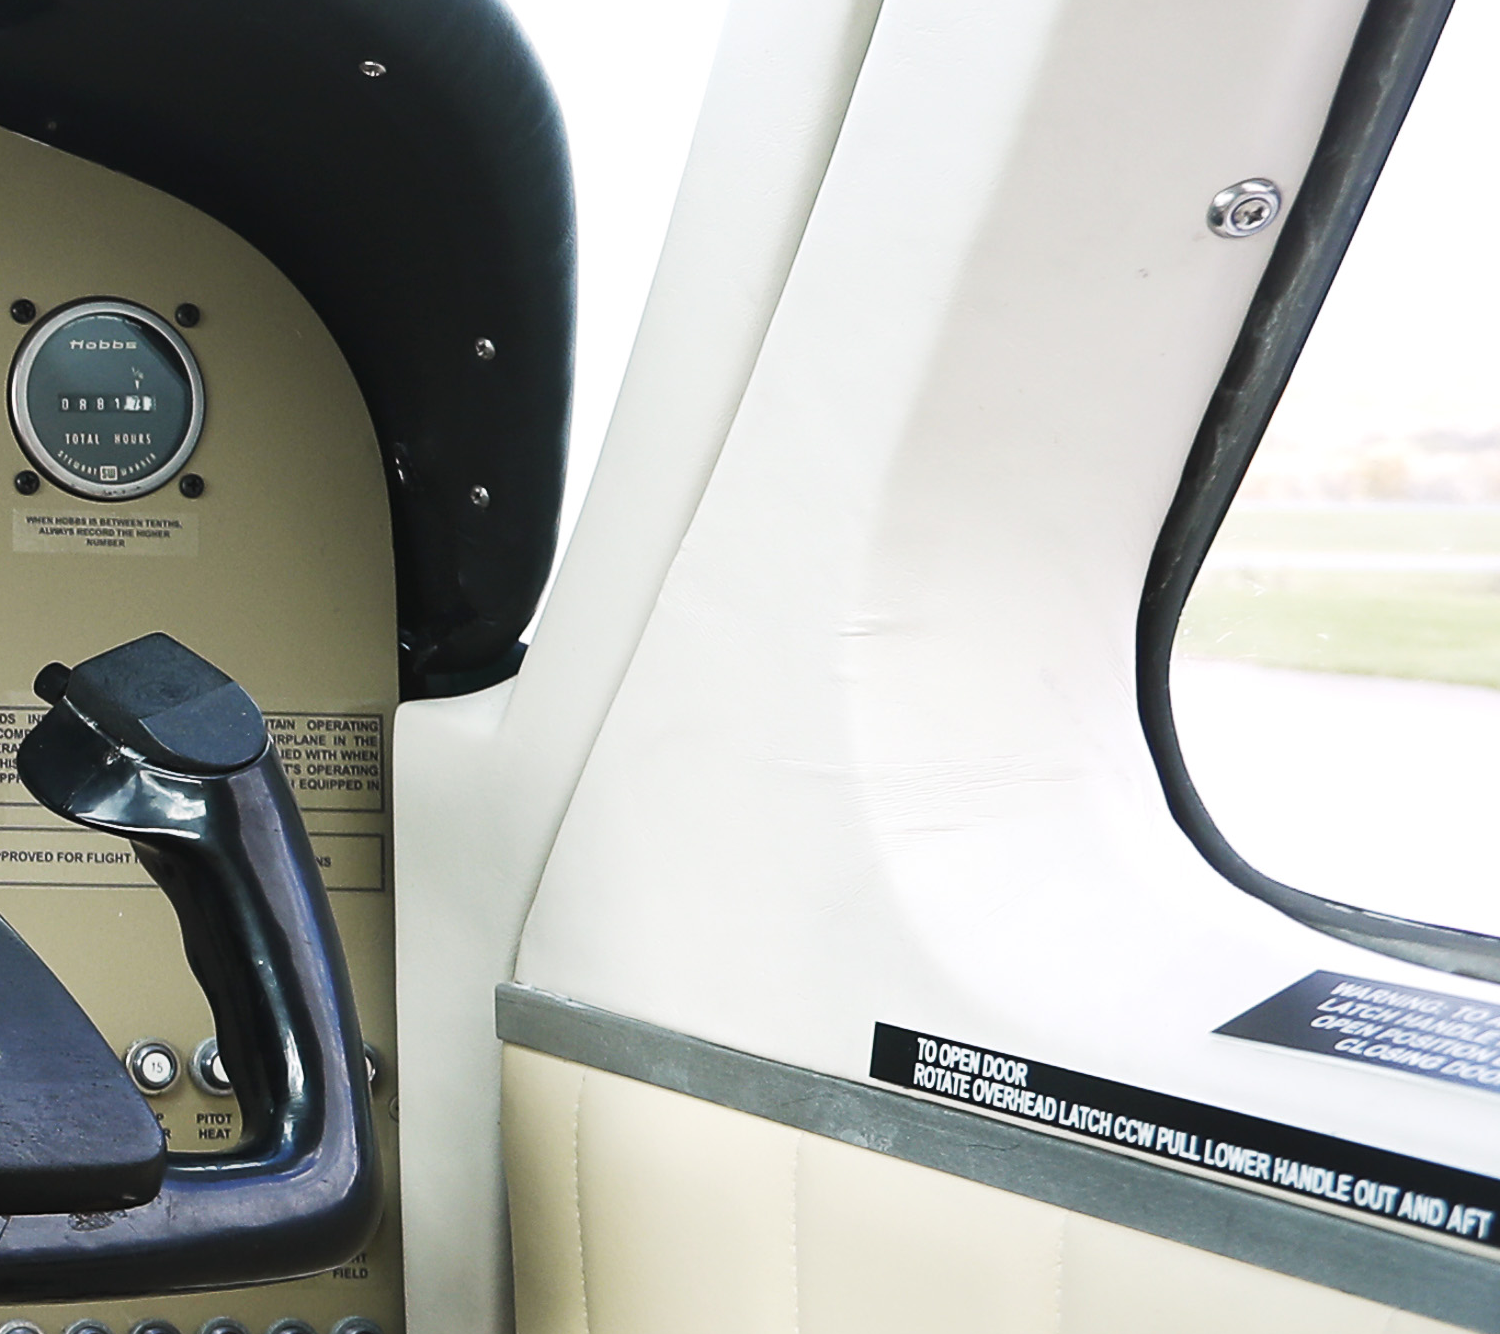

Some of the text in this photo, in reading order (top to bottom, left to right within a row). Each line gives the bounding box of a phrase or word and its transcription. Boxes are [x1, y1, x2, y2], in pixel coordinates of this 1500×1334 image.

[69, 339, 137, 351] Hobbs
[65, 433, 151, 445] TOTAL HOURS
[917, 1038, 1028, 1086] TO OPEN DOOR
[914, 1063, 1493, 1240] ROTATE OVERHEAD LATCH CCW PULL LOWER HANDLE OUT AND AFT
